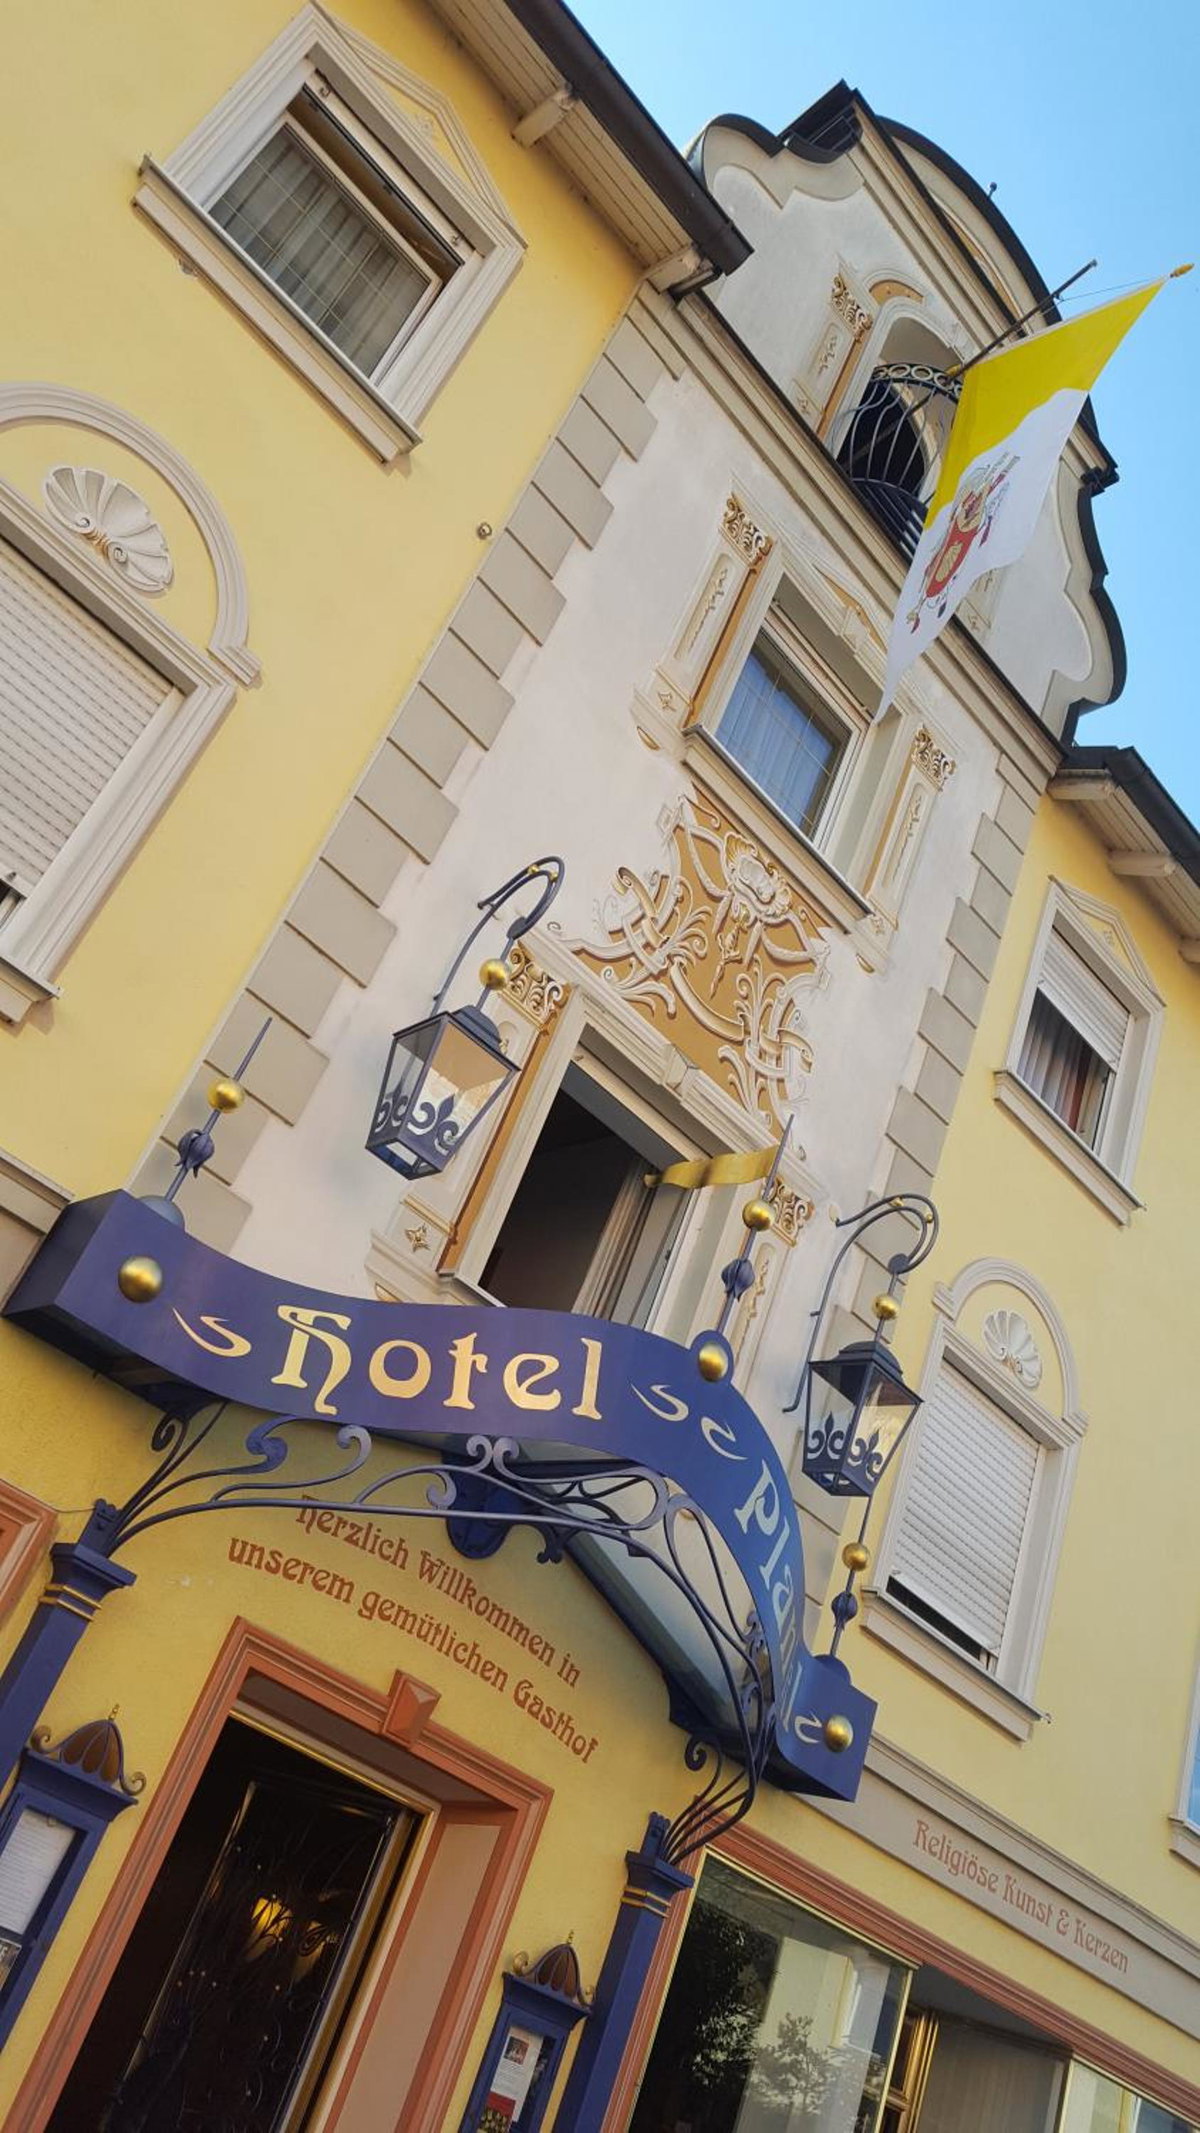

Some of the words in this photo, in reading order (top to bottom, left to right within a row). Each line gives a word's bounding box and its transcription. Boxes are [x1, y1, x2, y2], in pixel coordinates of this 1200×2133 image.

[270, 1304, 603, 1420] Hotel
[228, 1537, 355, 1605] unserem
[357, 1590, 509, 1693] gemütlichen
[513, 1678, 599, 1764] Gasthof
[295, 1494, 410, 1571] Herzlich
[418, 1549, 556, 1668] Willkommen
[557, 1652, 582, 1689] in
[912, 1819, 999, 1894] Religiöse
[1002, 1873, 1053, 1928] Kunst
[1056, 1908, 1070, 1937] &
[1073, 1914, 1129, 1974] Kerzen
